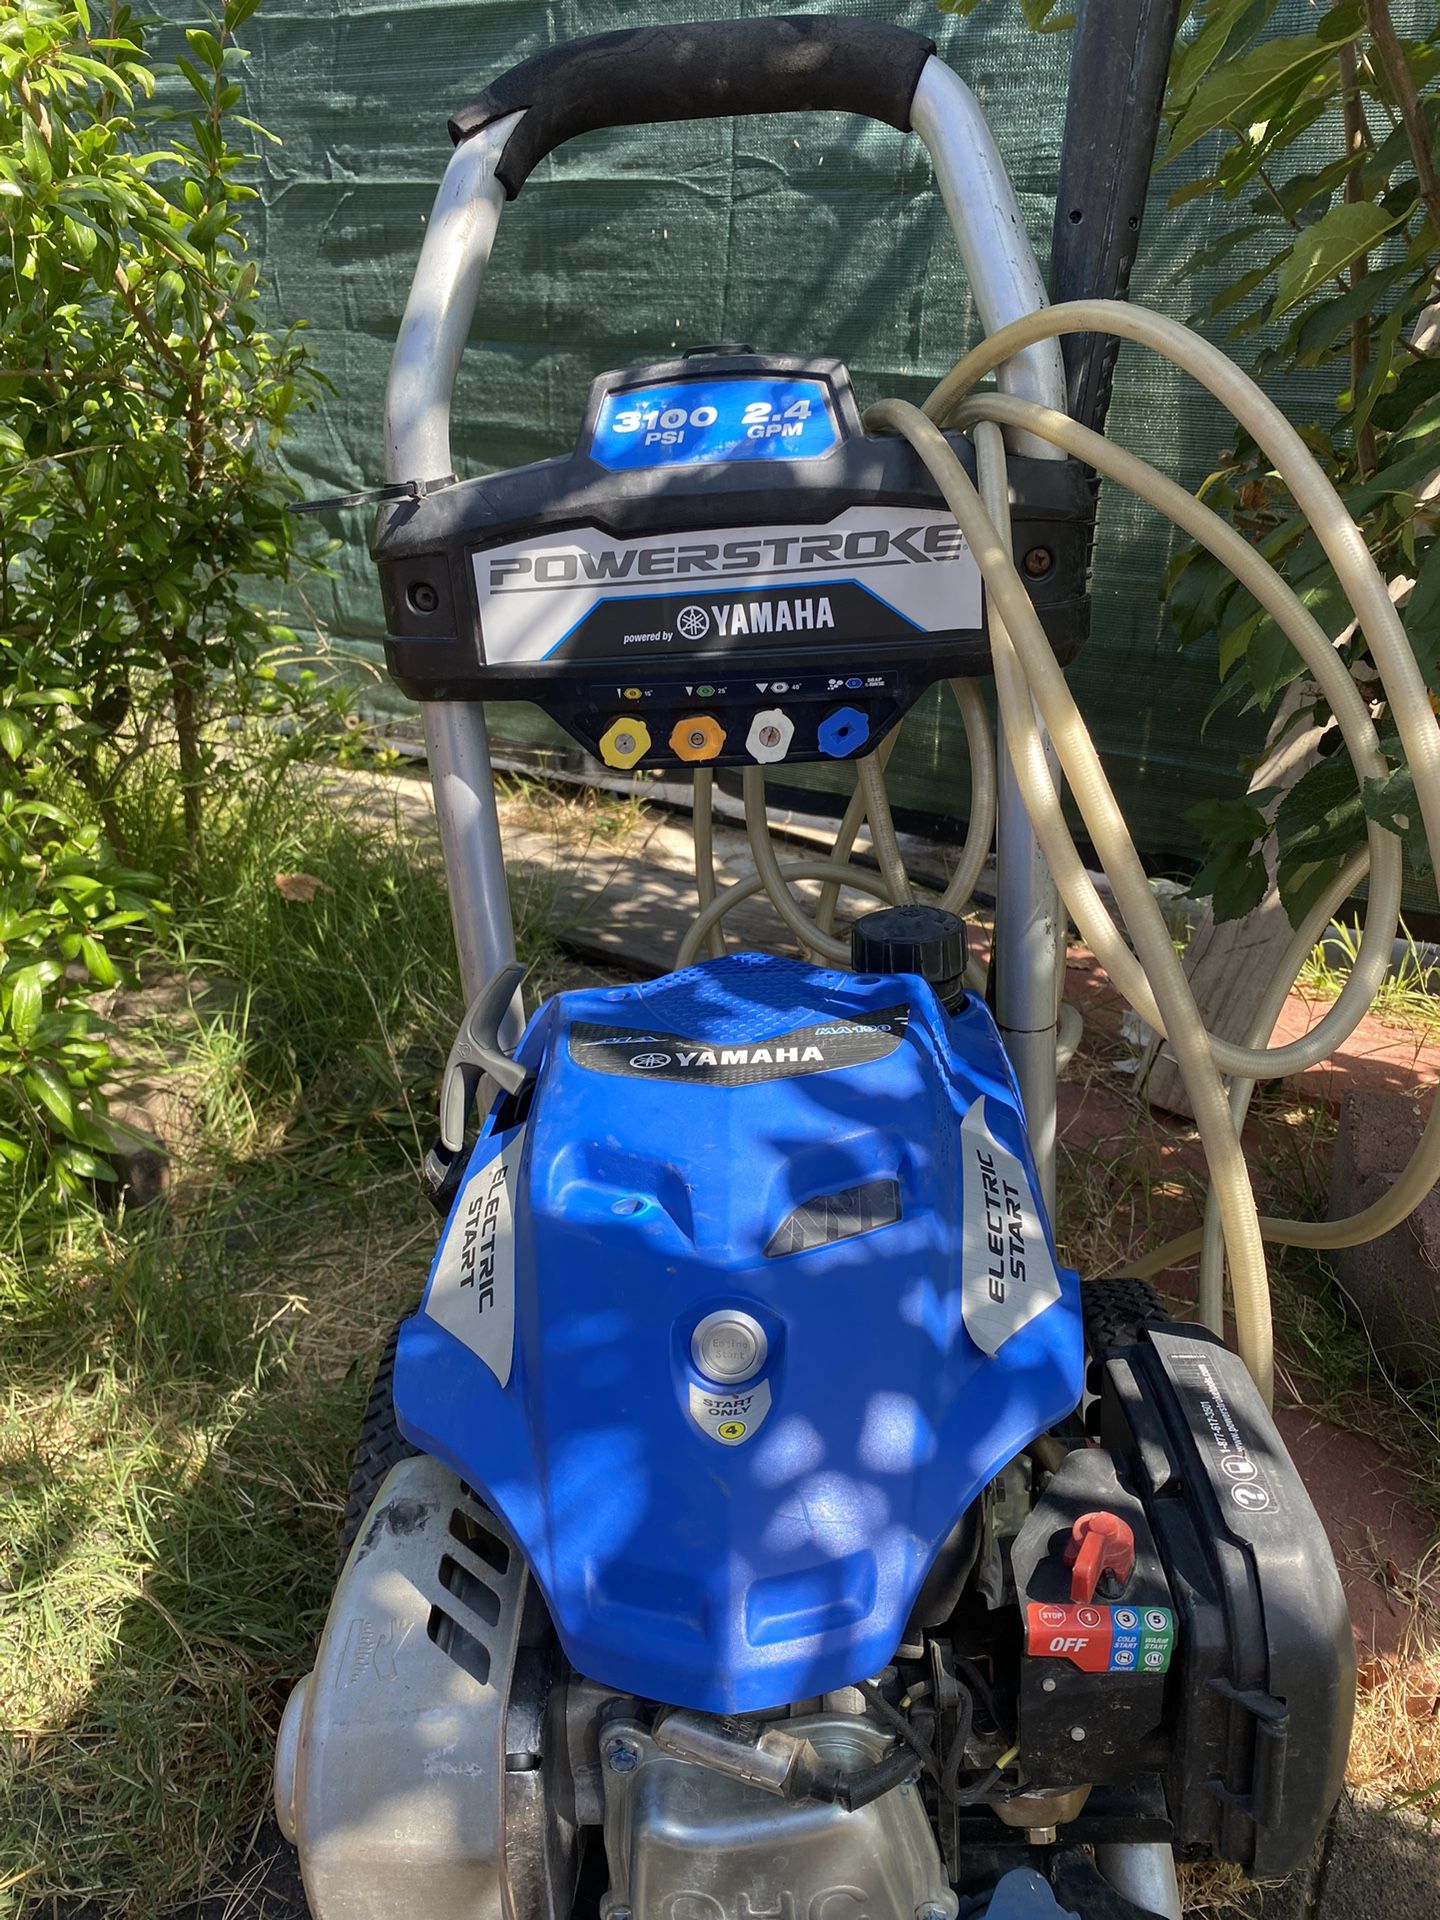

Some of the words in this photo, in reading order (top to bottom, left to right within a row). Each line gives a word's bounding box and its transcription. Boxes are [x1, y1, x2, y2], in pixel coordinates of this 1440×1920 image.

[612, 406, 717, 433] 3100
[740, 400, 811, 424] 2.4
[645, 431, 685, 445] PSI
[747, 422, 803, 439] GPM
[489, 523, 964, 586] POWERSTROKE
[623, 632, 662, 646] powered
[662, 631, 674, 644] by
[711, 597, 835, 637] YAMAHA
[676, 1046, 825, 1068] YAMAHA
[976, 1149, 1005, 1304] ELECTRIC
[1003, 1180, 1026, 1282] START
[460, 1197, 484, 1288] START
[479, 1165, 508, 1314] ELECTRIC
[703, 1395, 754, 1409] START
[708, 1405, 752, 1416] ONLY
[725, 1425, 738, 1435] 4
[1042, 1612, 1063, 1620] STOP
[1084, 1613, 1092, 1622] 1
[1122, 1614, 1130, 1622] 3
[1153, 1615, 1161, 1624] 5
[1050, 1637, 1089, 1652] OFF
